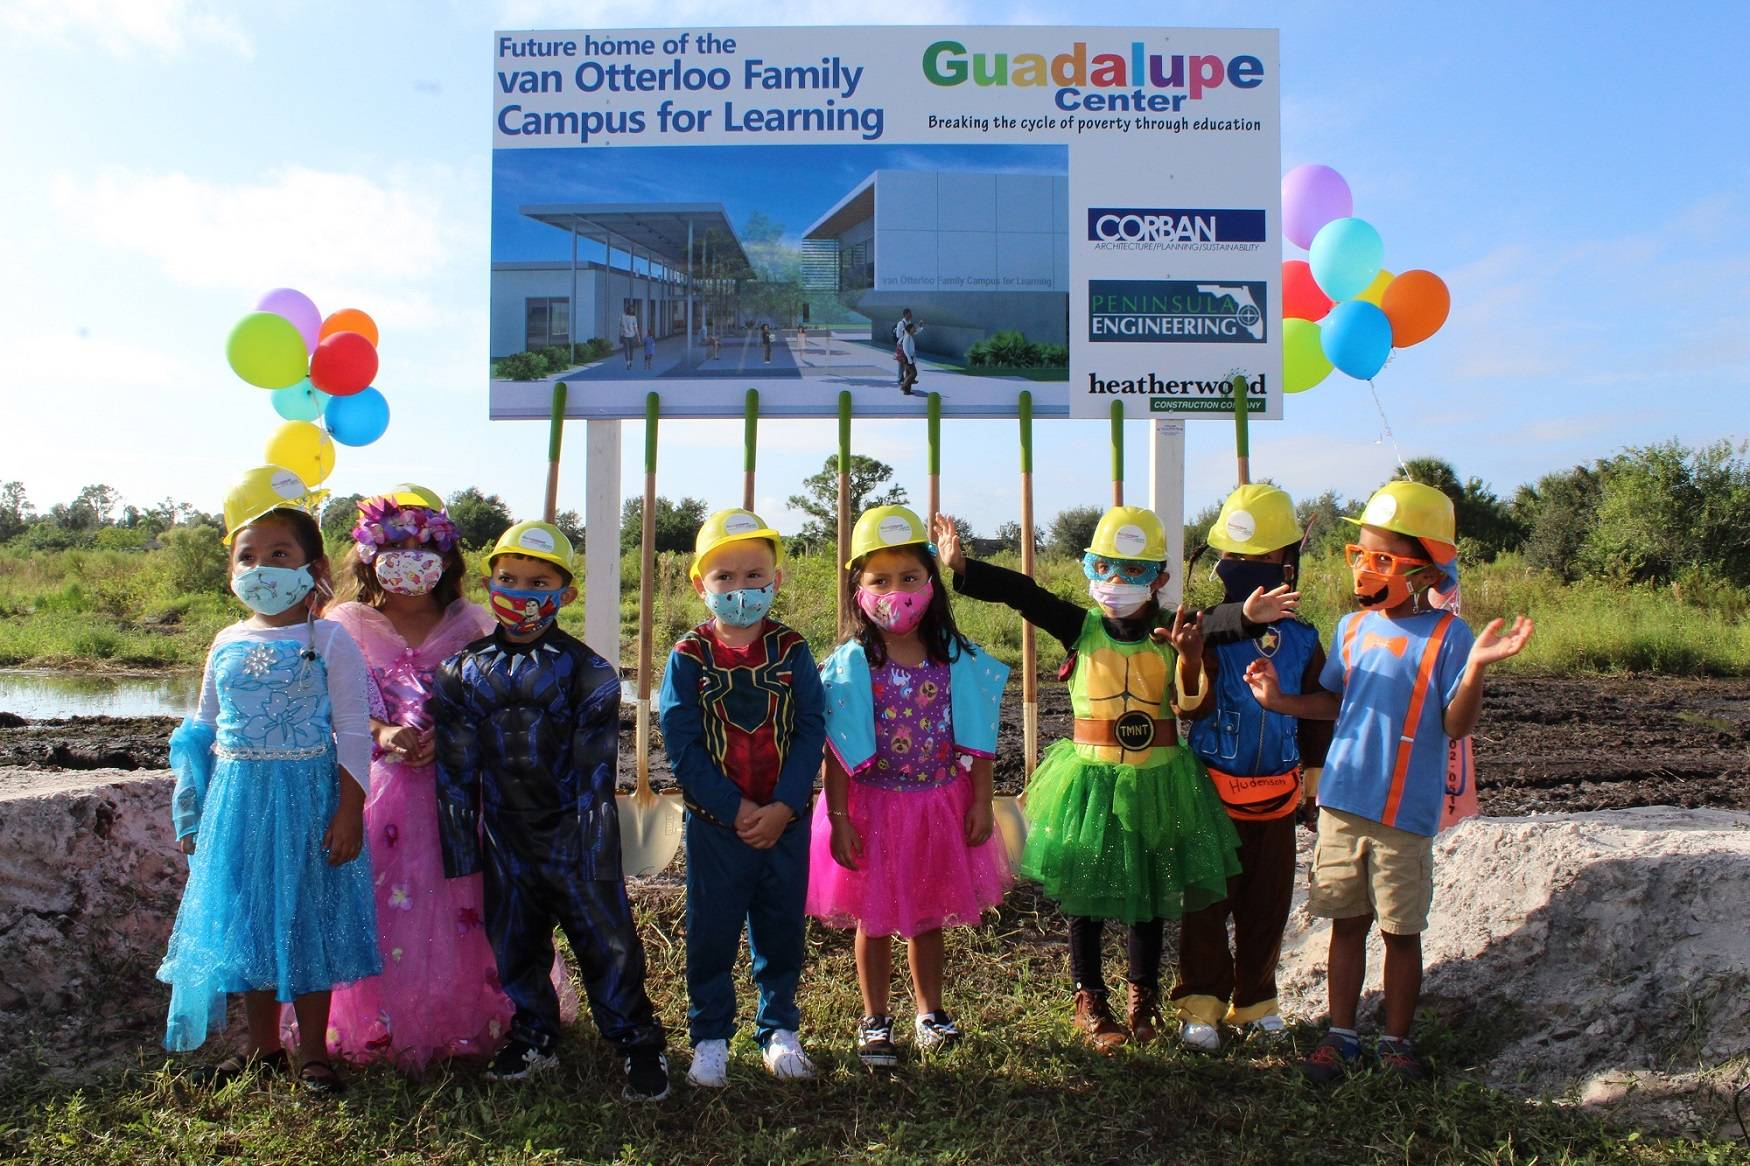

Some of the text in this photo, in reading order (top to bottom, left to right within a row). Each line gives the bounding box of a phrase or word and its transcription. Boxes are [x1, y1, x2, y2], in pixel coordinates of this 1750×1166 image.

[500, 33, 736, 57] Future home of the
[498, 57, 864, 98] van Otterloo Family
[922, 41, 1265, 100] Guadalupe
[1054, 87, 1187, 113] Center
[498, 99, 884, 143] Campus for Learning
[928, 115, 1261, 134] Breaking the cycle of poverty through education
[1096, 214, 1216, 241] CORBAN
[1092, 295, 1235, 313] PENINSULA
[1092, 317, 1237, 335] ENGINEERING
[1088, 372, 1267, 395] heatherwod
[1154, 401, 1219, 409] CONSTRUCTION
[1120, 724, 1149, 737] TMNT
